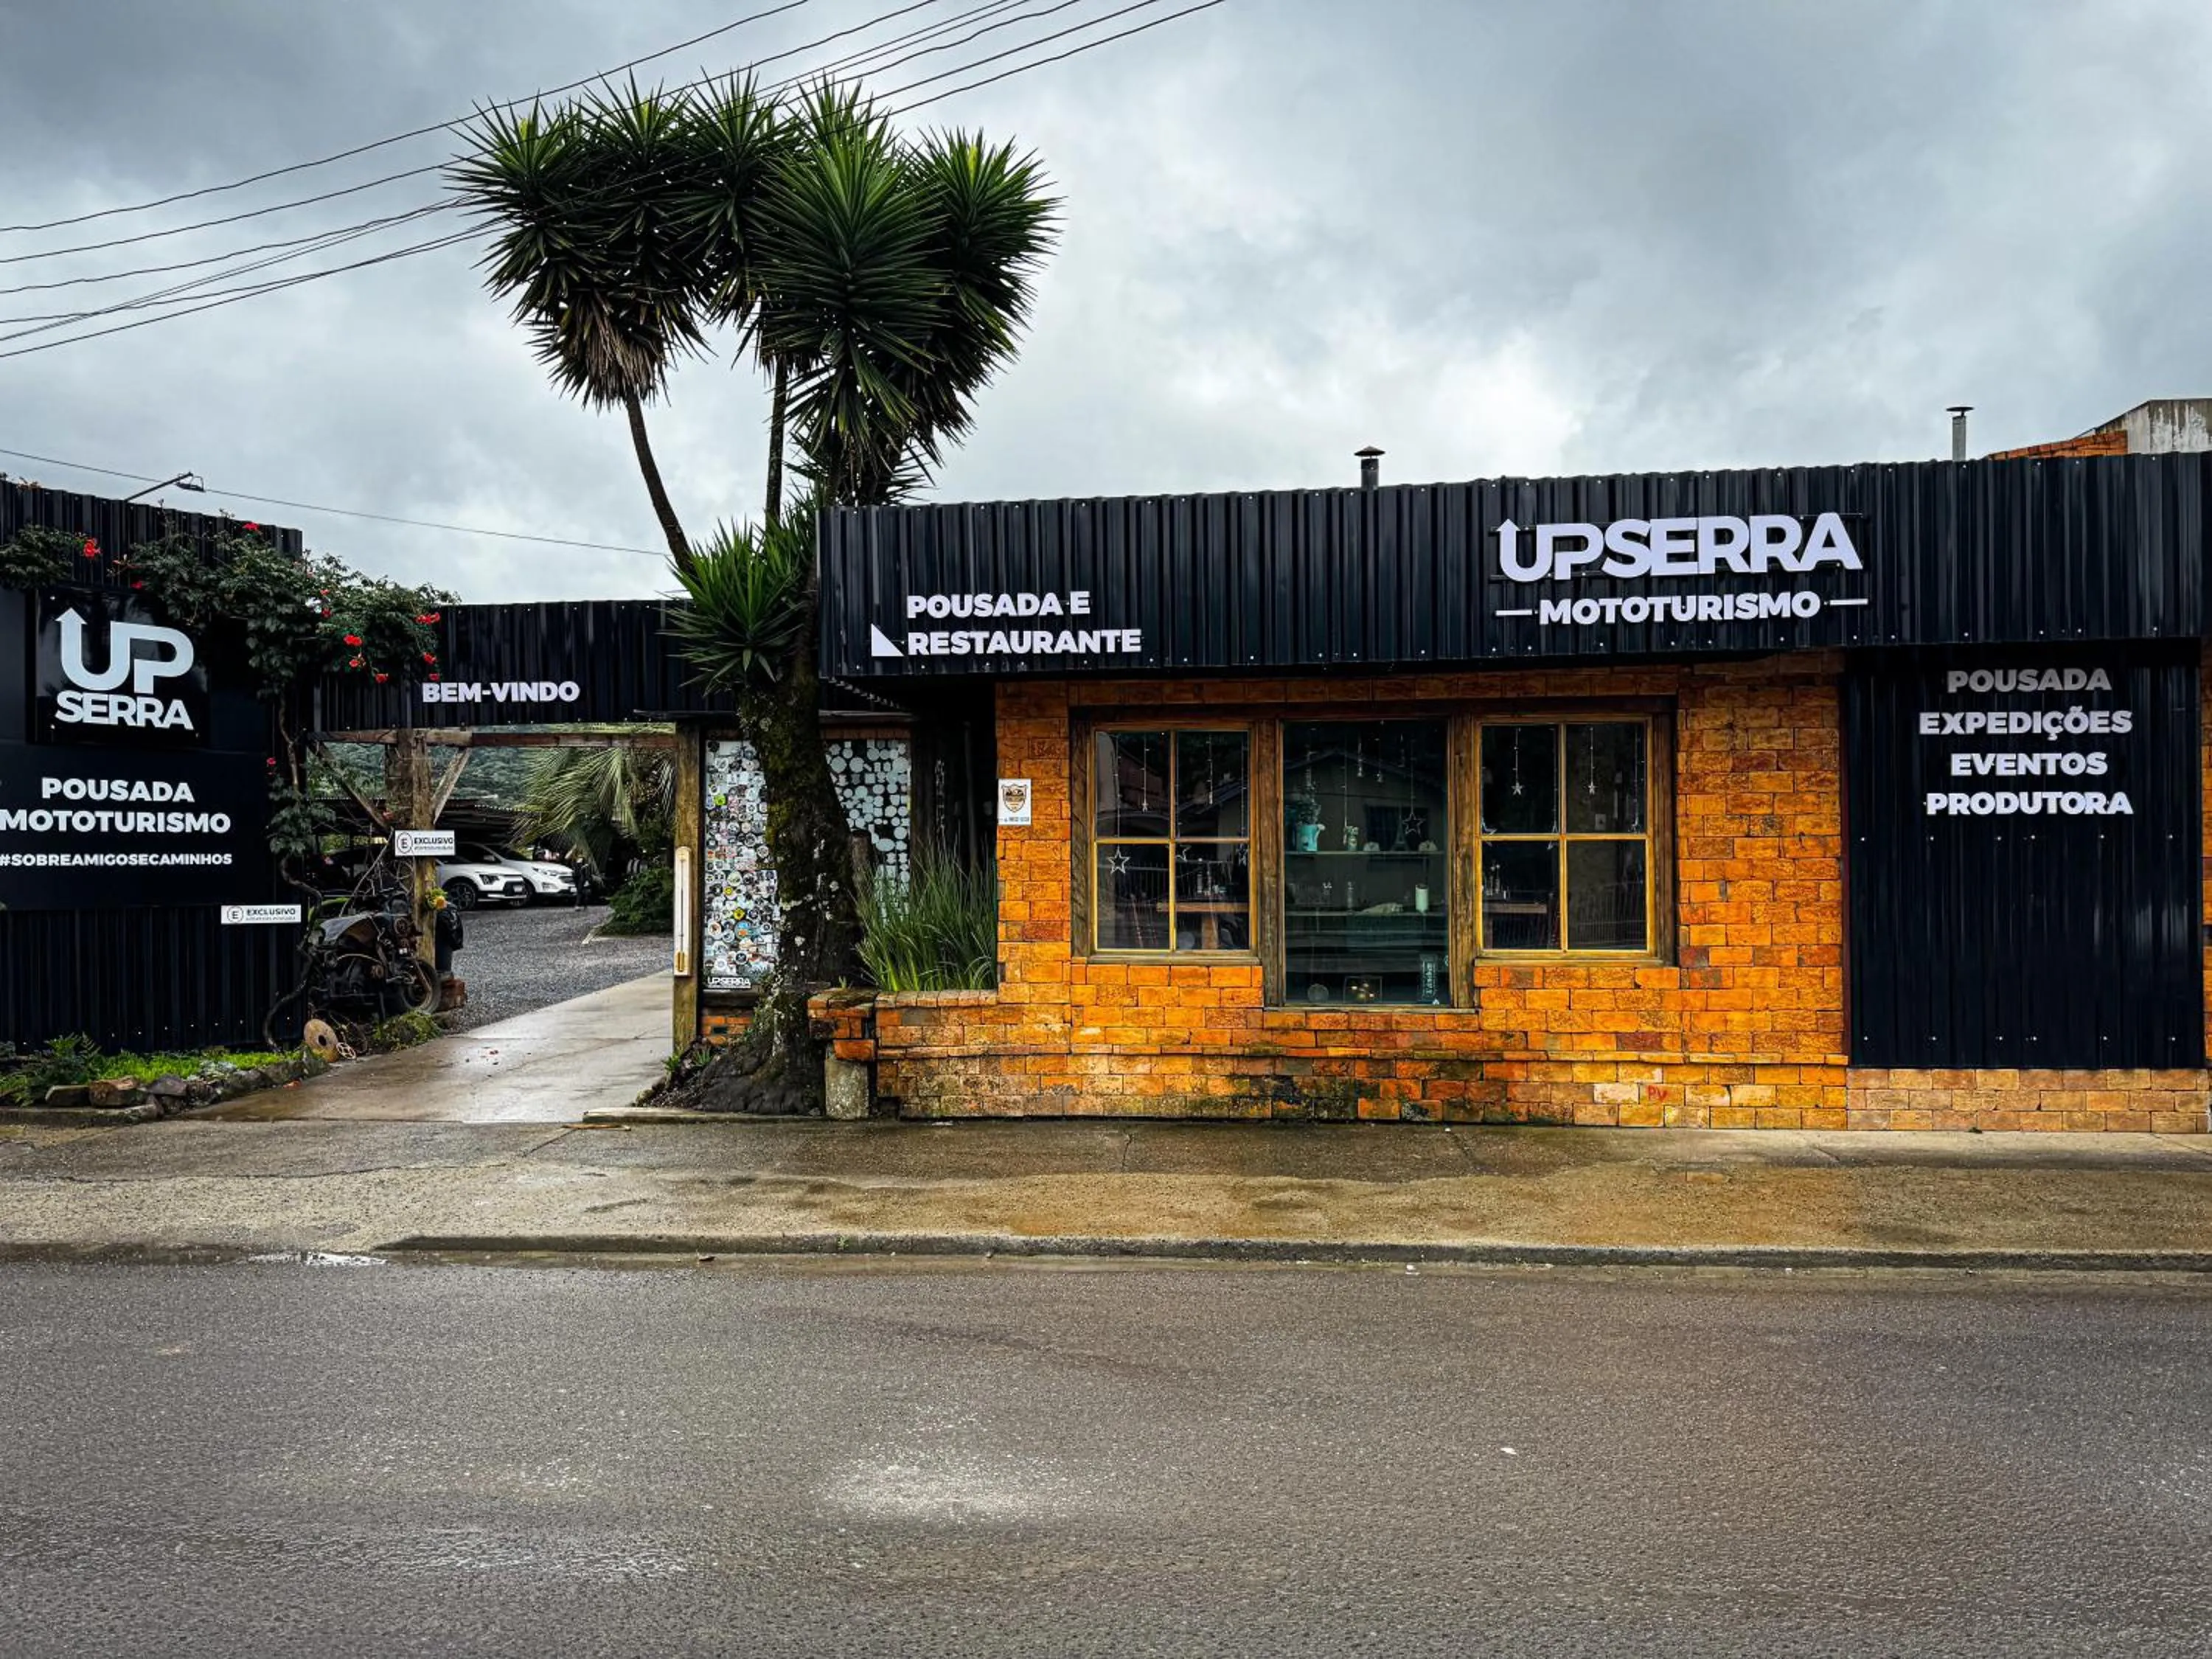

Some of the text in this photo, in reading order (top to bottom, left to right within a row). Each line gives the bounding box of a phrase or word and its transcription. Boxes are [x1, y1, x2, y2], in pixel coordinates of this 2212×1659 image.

[906, 591, 1091, 619] POUSADA E
[1539, 591, 1821, 625] MOTOTURISMO
[55, 607, 194, 694] UP
[908, 629, 1141, 655] RESTAURANTE
[422, 681, 580, 703] BEM-VINDO
[1947, 668, 2112, 693] POUSADA
[55, 690, 194, 731] SERRA
[1919, 706, 2133, 741] EXPEDIÇÕES
[1951, 752, 2108, 776] EVENTOS
[41, 777, 195, 803] POUSADA
[1927, 791, 2134, 815] PRODUTORA
[0, 809, 232, 833] MOTOTURISMO
[0, 853, 232, 866] #SOBREAMIGOSECAMINHOS
[246, 908, 296, 916] EXCLUSIVO
